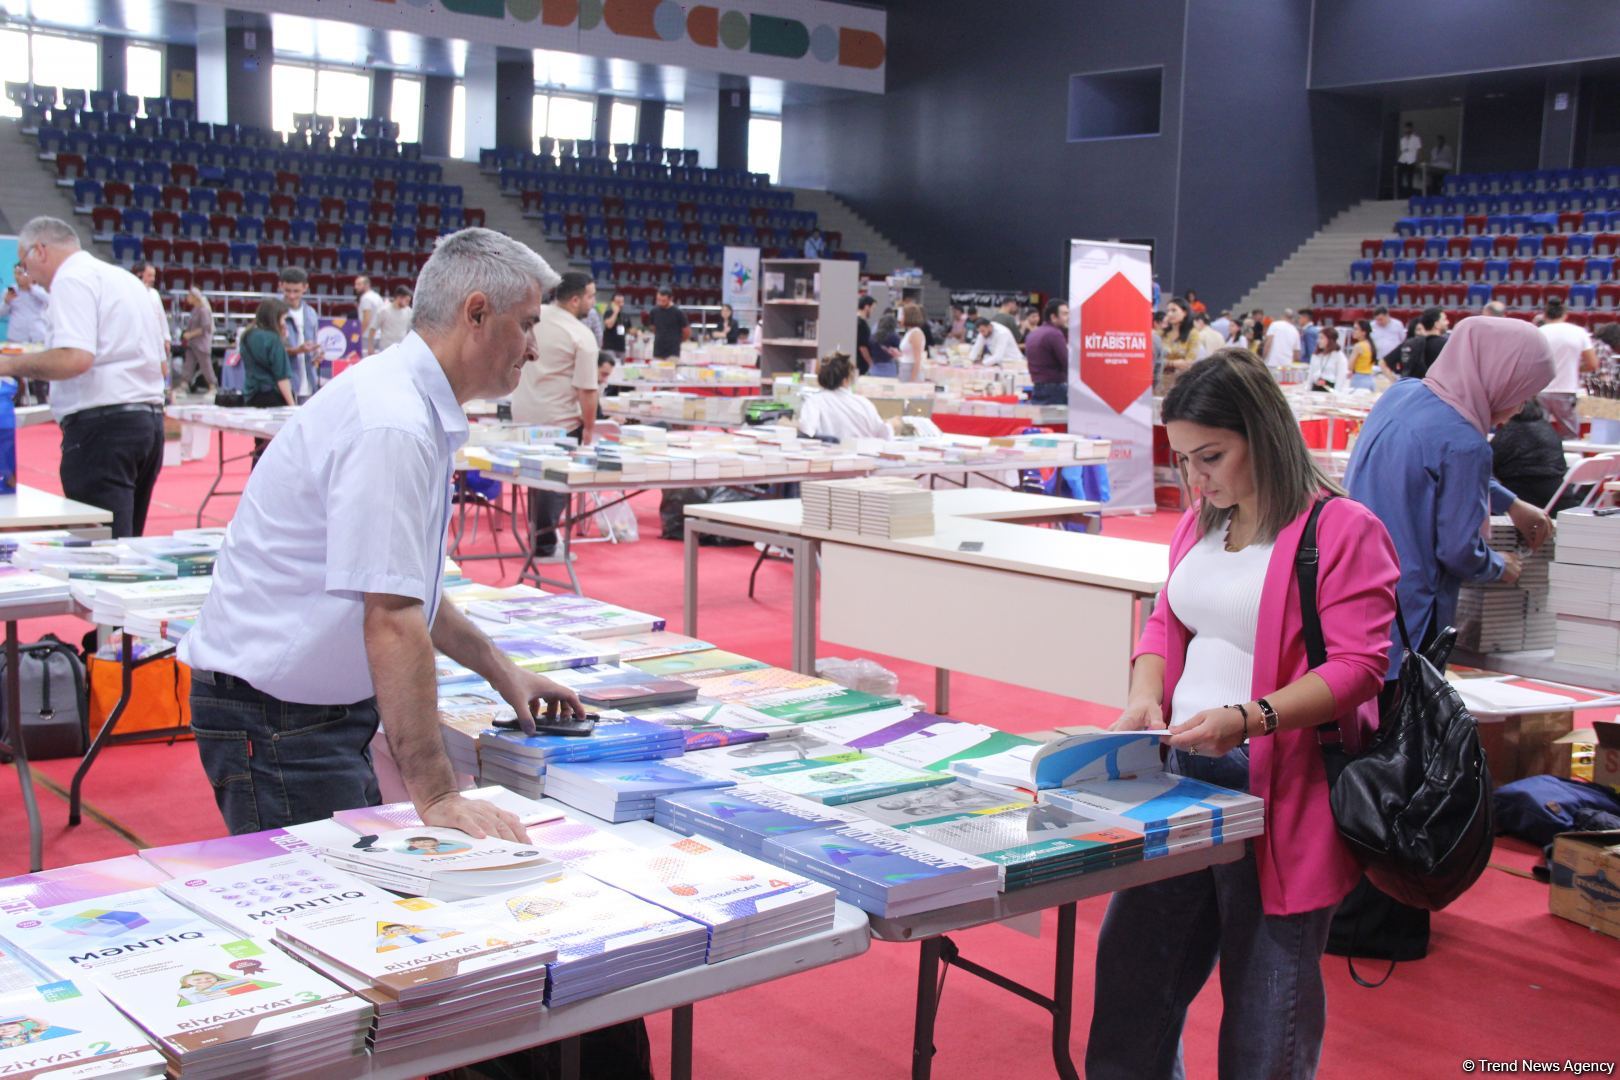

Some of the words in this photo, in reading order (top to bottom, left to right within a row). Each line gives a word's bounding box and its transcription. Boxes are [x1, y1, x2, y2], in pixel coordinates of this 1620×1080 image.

[768, 879, 791, 888] 4
[248, 890, 367, 921] MƏNTİQ
[69, 931, 205, 964] MƏNTİQ
[384, 944, 483, 972] RİYAZİYYAT
[176, 998, 294, 1030] RİYAZİYYAT
[294, 991, 322, 1003] 3
[88, 1041, 118, 1056] 2
